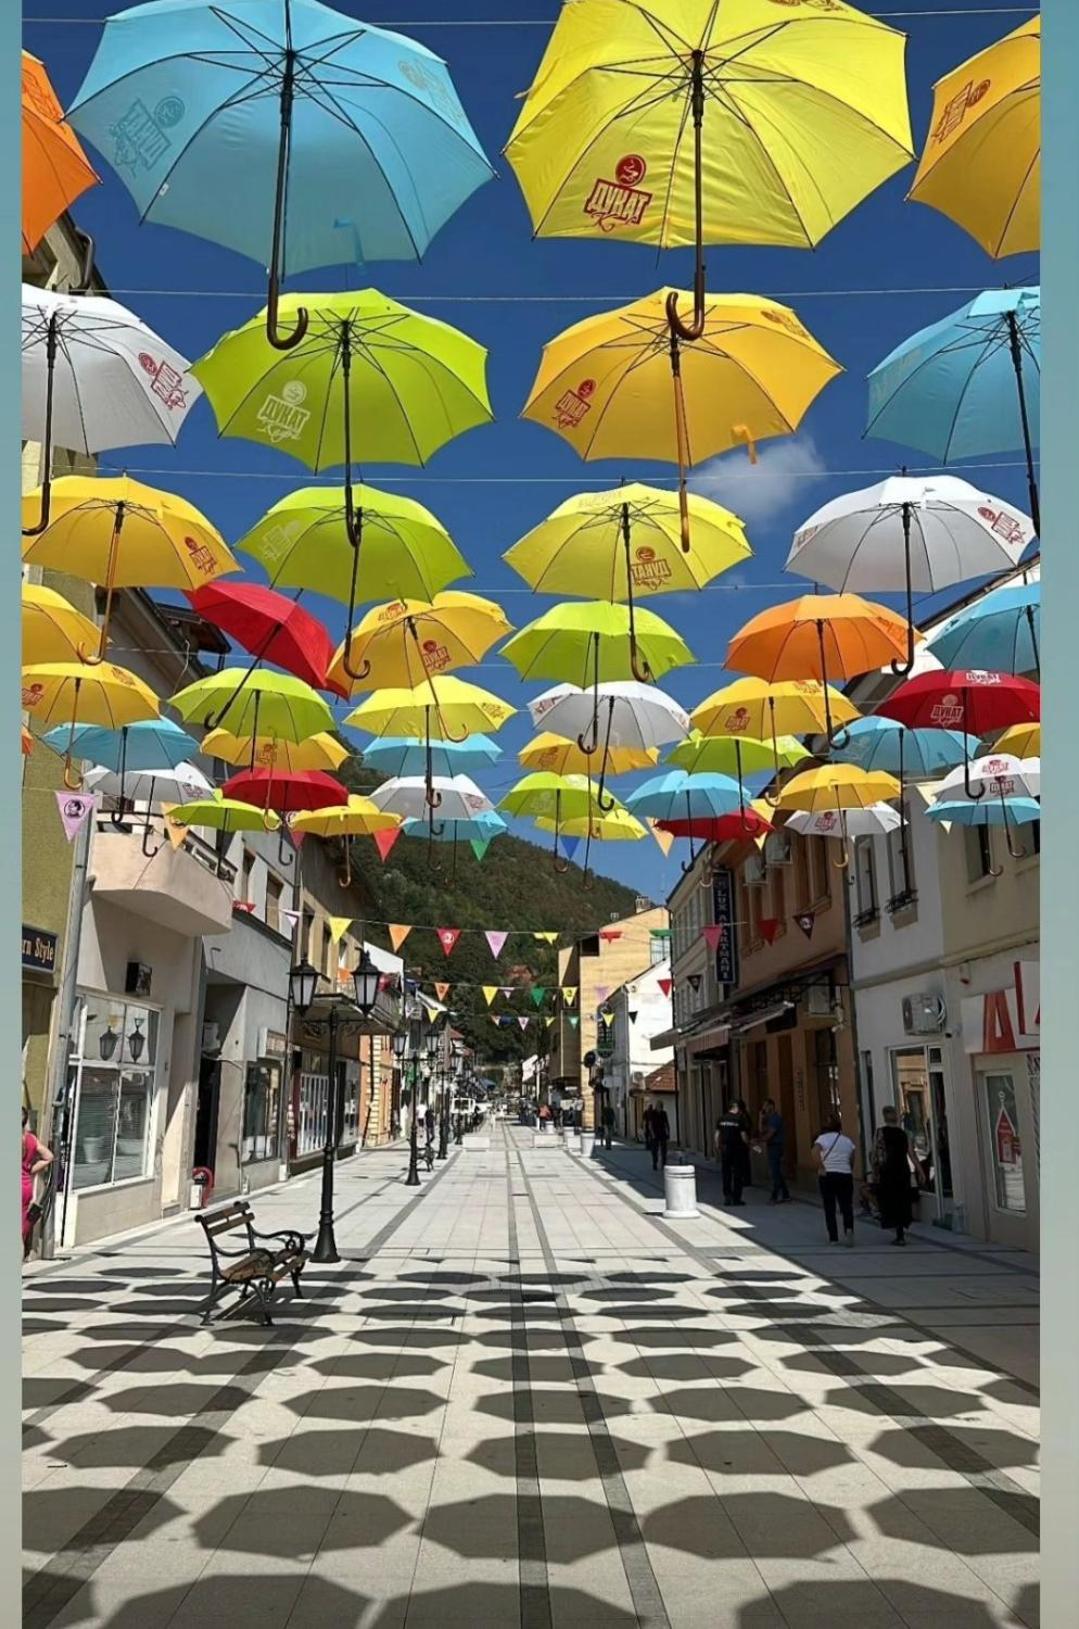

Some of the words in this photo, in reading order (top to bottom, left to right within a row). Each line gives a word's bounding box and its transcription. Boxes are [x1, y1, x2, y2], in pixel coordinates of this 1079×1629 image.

[587, 181, 650, 222] ДУКАТ
[260, 397, 308, 433] ДУКАТ
[34, 936, 54, 963] Style
